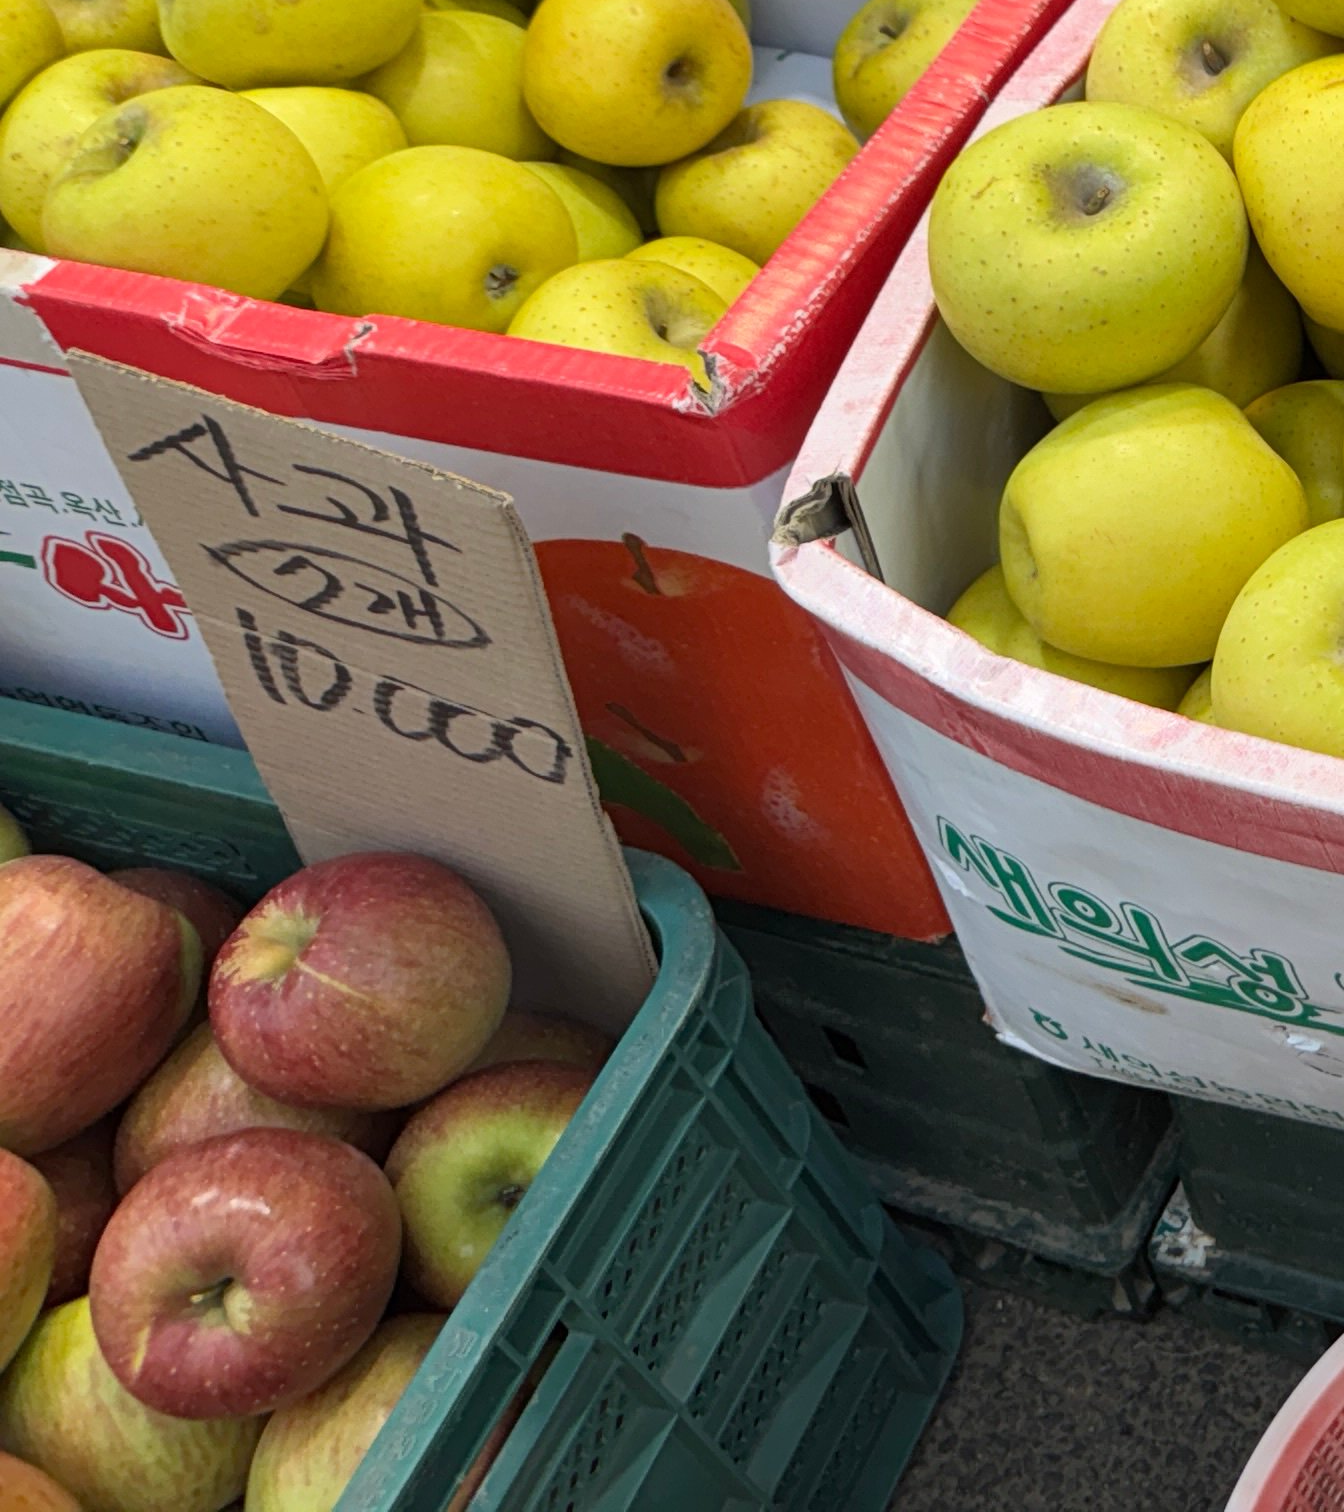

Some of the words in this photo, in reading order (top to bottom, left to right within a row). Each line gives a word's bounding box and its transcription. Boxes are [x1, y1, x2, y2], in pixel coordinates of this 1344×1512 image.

[127, 413, 463, 589] 사과
[272, 554, 446, 642] 2개
[937, 814, 1310, 1019] 새의성
